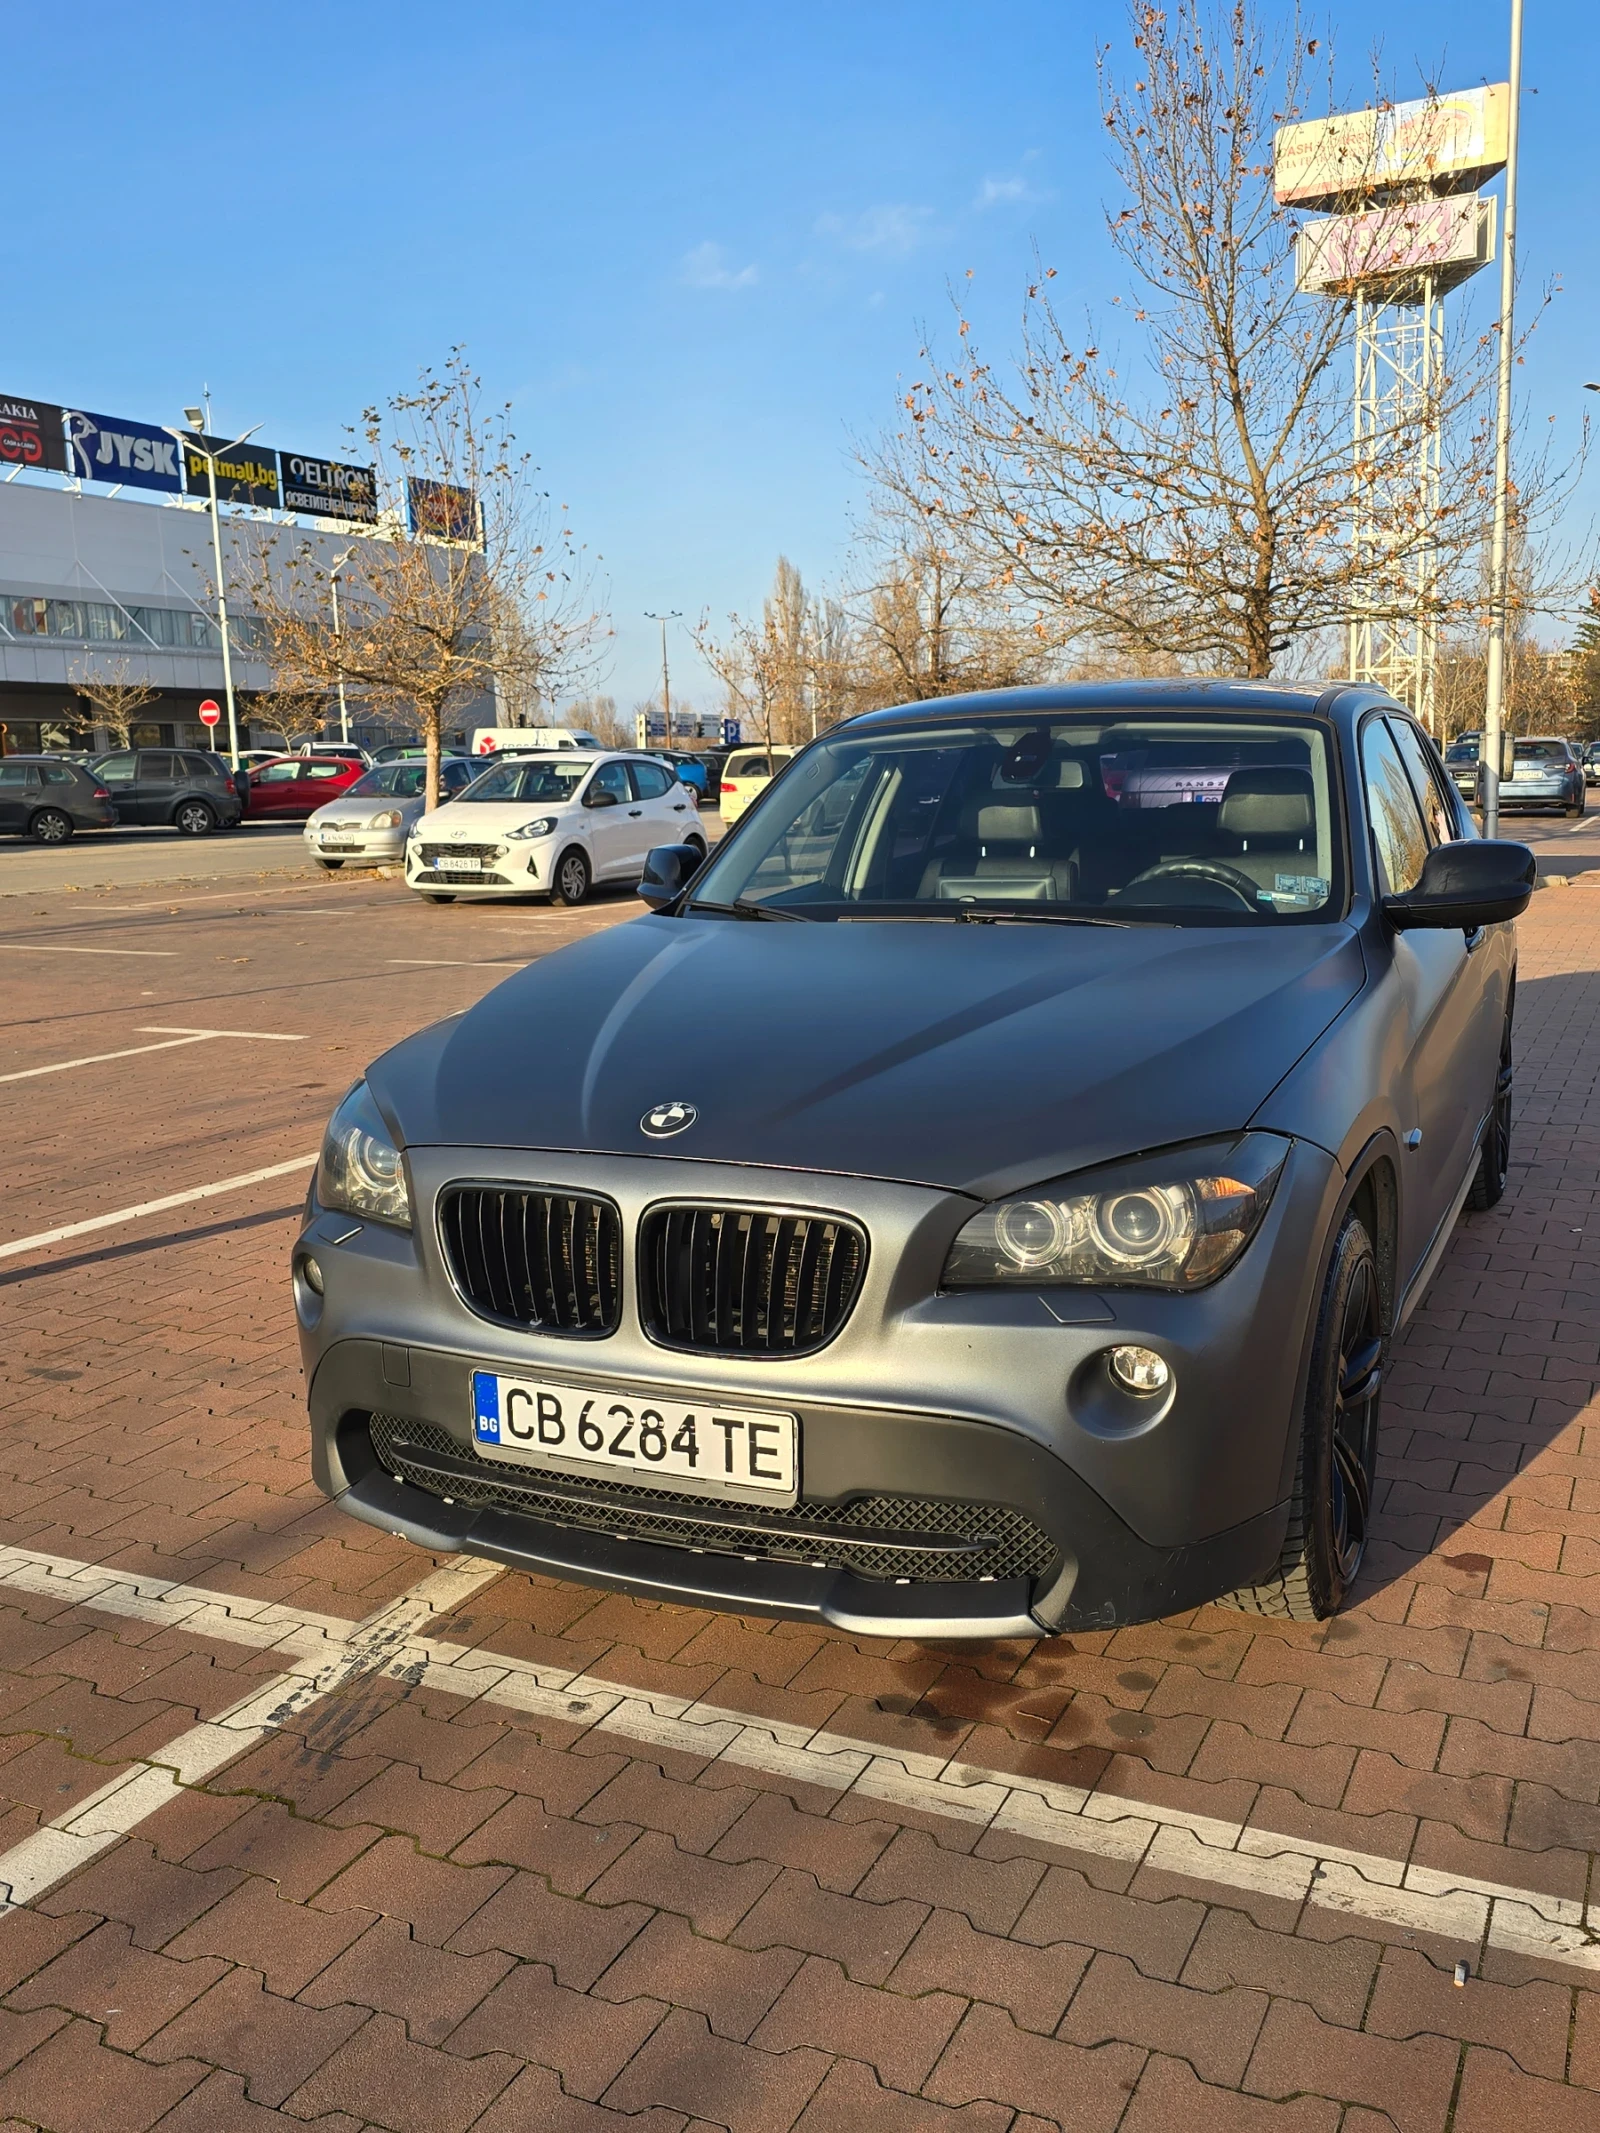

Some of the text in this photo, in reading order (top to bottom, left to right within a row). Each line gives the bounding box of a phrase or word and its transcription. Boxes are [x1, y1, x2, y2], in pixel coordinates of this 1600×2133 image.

[96, 431, 179, 476] JYSK
[189, 455, 277, 491] petmall.bg
[727, 722, 738, 743] P
[469, 860, 480, 868] TP
[479, 1415, 498, 1434] BG
[506, 1388, 783, 1481] CB 6284 TE
